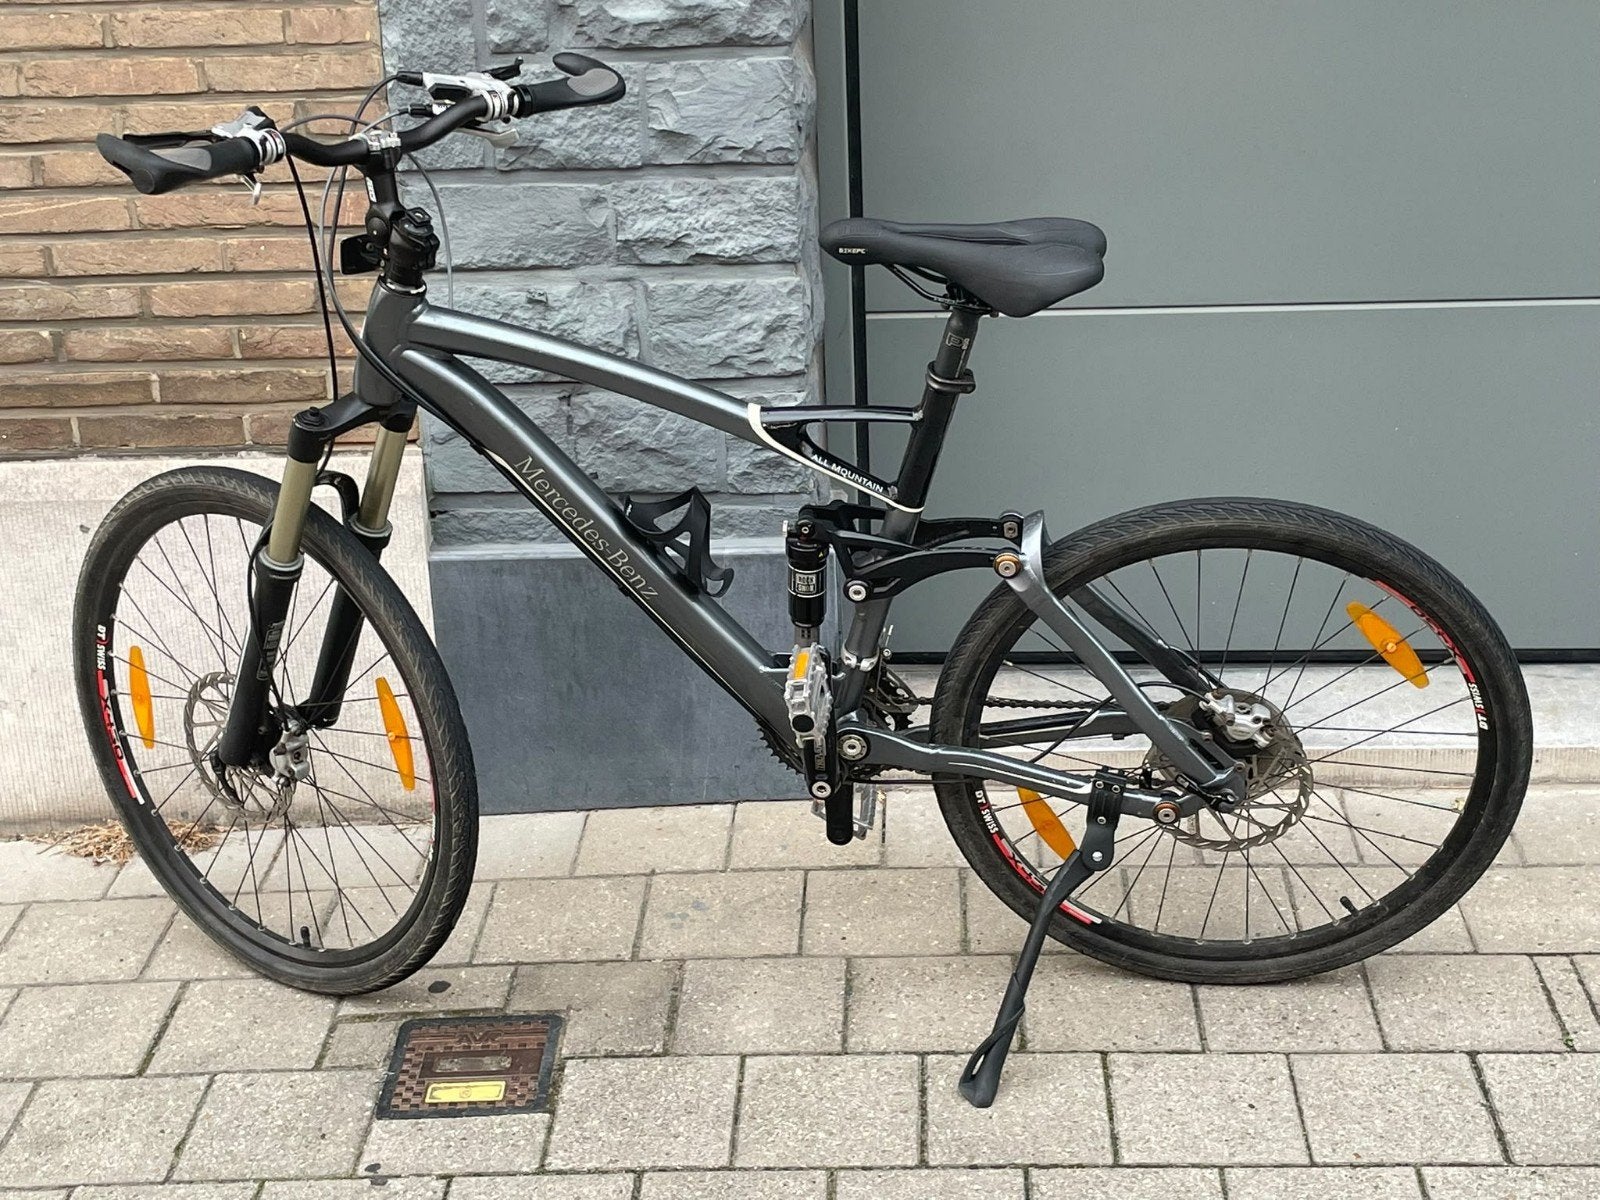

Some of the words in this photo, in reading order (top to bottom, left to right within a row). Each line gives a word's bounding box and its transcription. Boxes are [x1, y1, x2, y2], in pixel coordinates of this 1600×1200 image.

[811, 453, 829, 468] ALL
[831, 463, 884, 493] MOUNTAIN
[514, 456, 659, 600] Mercedes-Benz
[97, 624, 106, 641] DT
[97, 645, 106, 671] SWISS
[1468, 683, 1485, 709] SWISS
[975, 790, 986, 804] DT
[981, 808, 999, 834] SWISS
